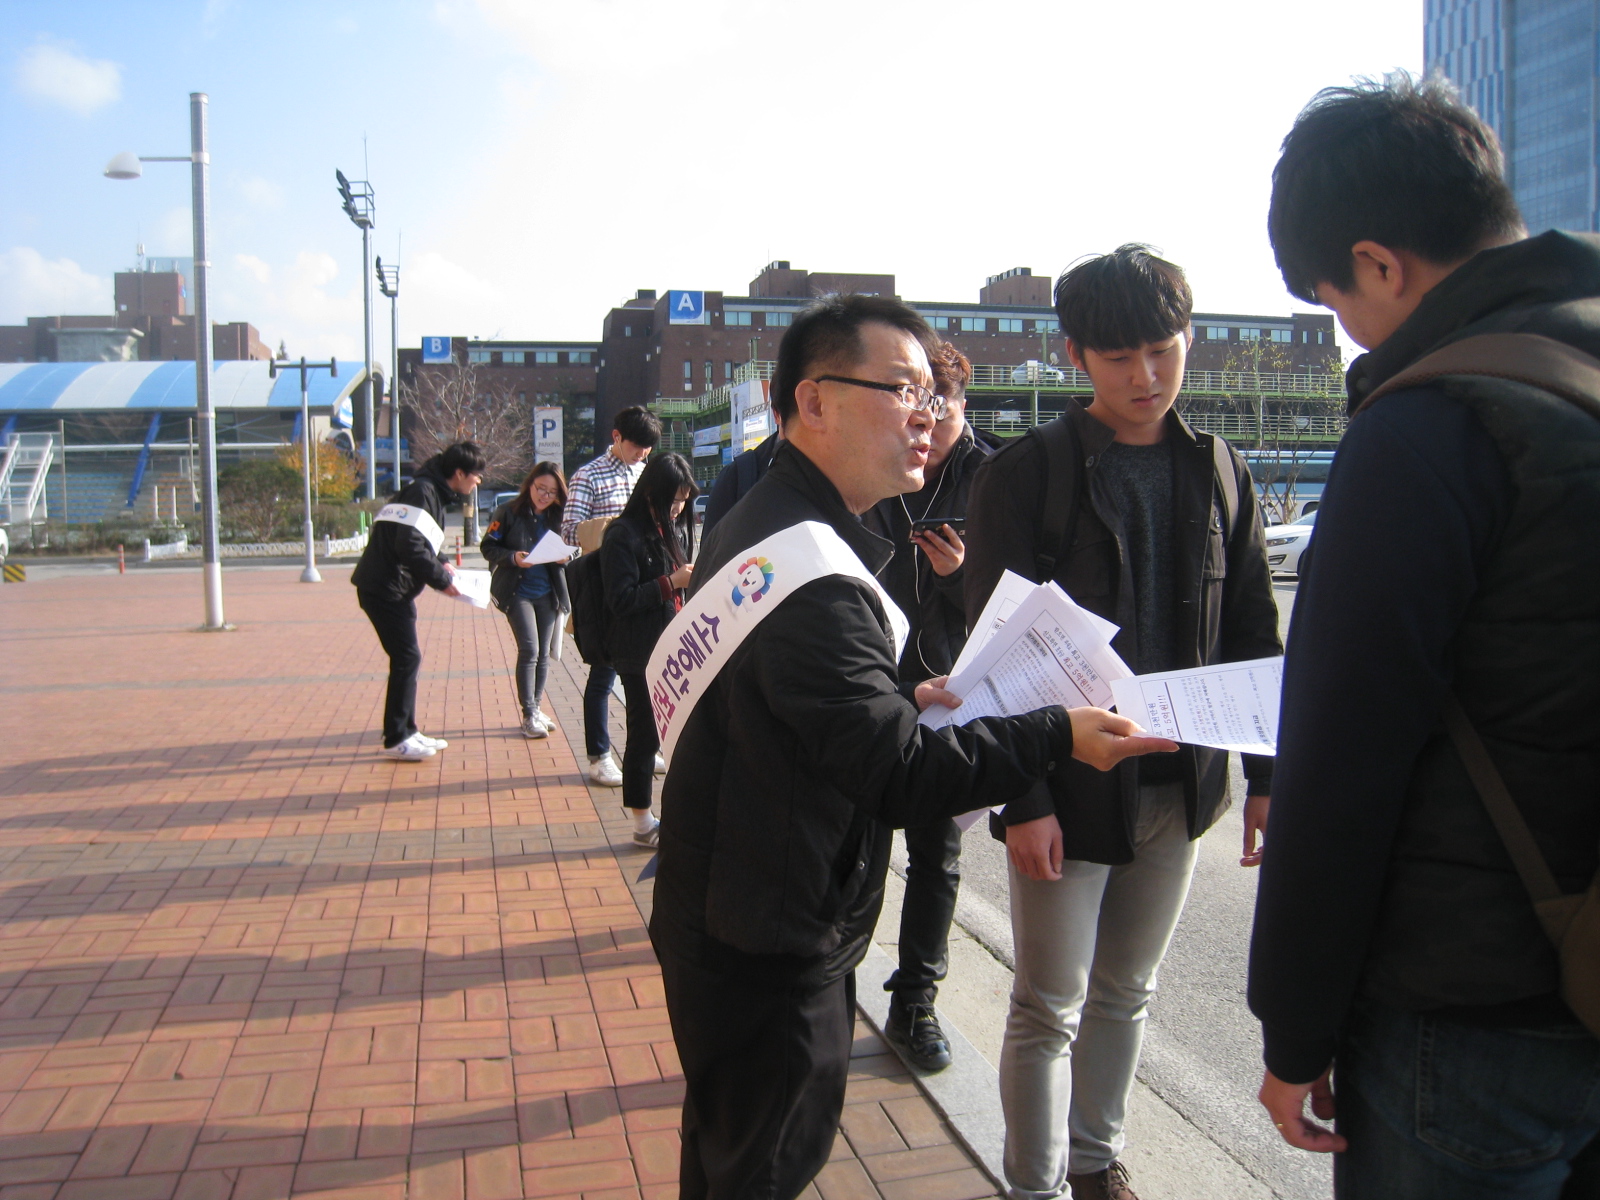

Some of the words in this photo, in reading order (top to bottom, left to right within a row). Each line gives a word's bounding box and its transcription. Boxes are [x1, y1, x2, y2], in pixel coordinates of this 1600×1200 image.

[677, 292, 695, 311] A
[431, 337, 442, 353] B
[542, 418, 556, 438] P
[1078, 659, 1098, 682] 3천만원
[1147, 702, 1161, 727] 3천만원
